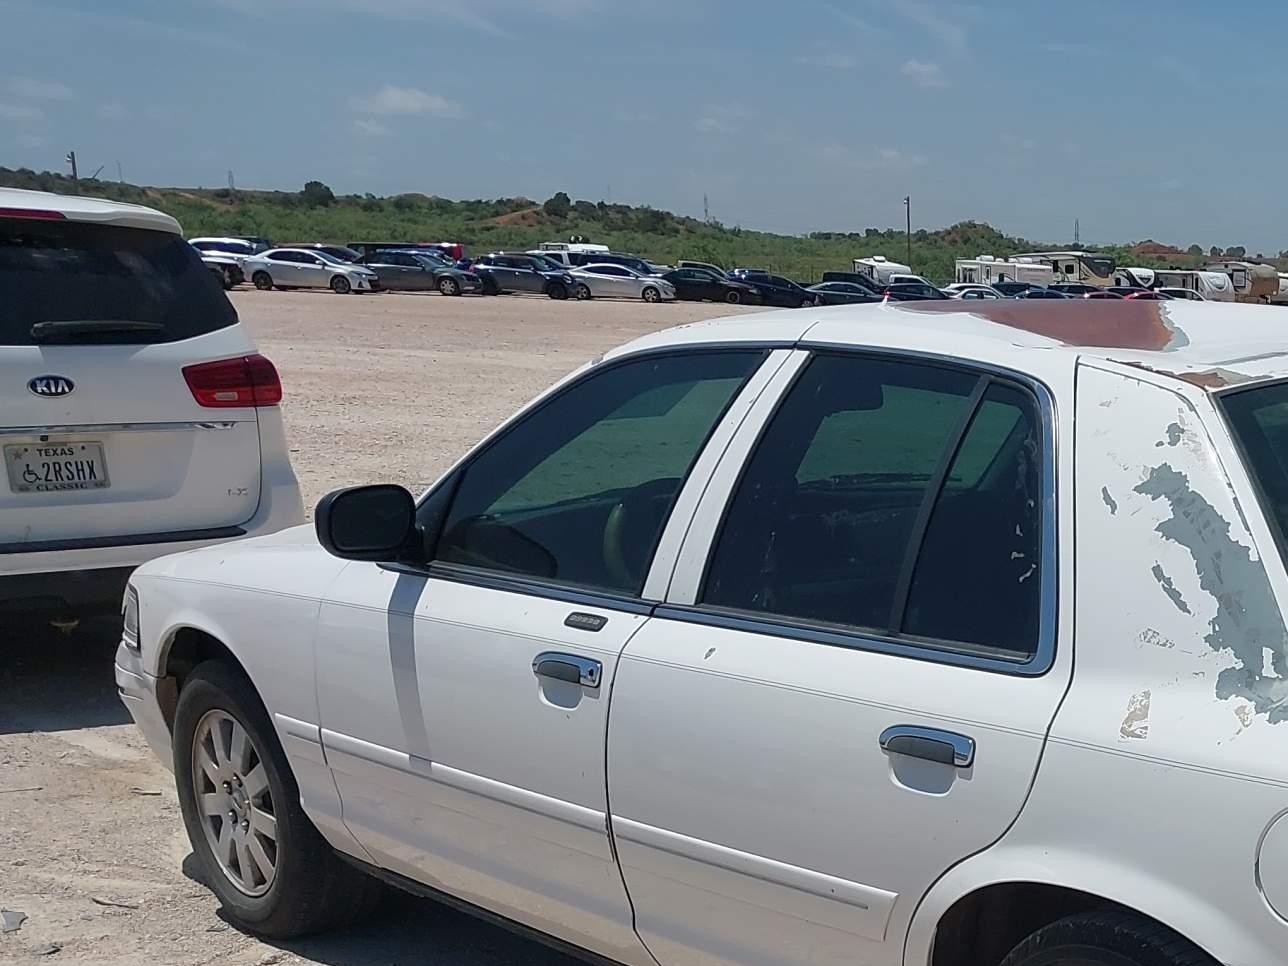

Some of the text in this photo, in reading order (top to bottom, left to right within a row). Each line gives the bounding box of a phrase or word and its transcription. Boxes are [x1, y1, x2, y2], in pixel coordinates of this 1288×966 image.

[35, 379, 69, 393] KIA
[36, 447, 74, 457] TEXAS
[42, 460, 97, 482] 2RSHX
[36, 482, 88, 492] CLASSIC
